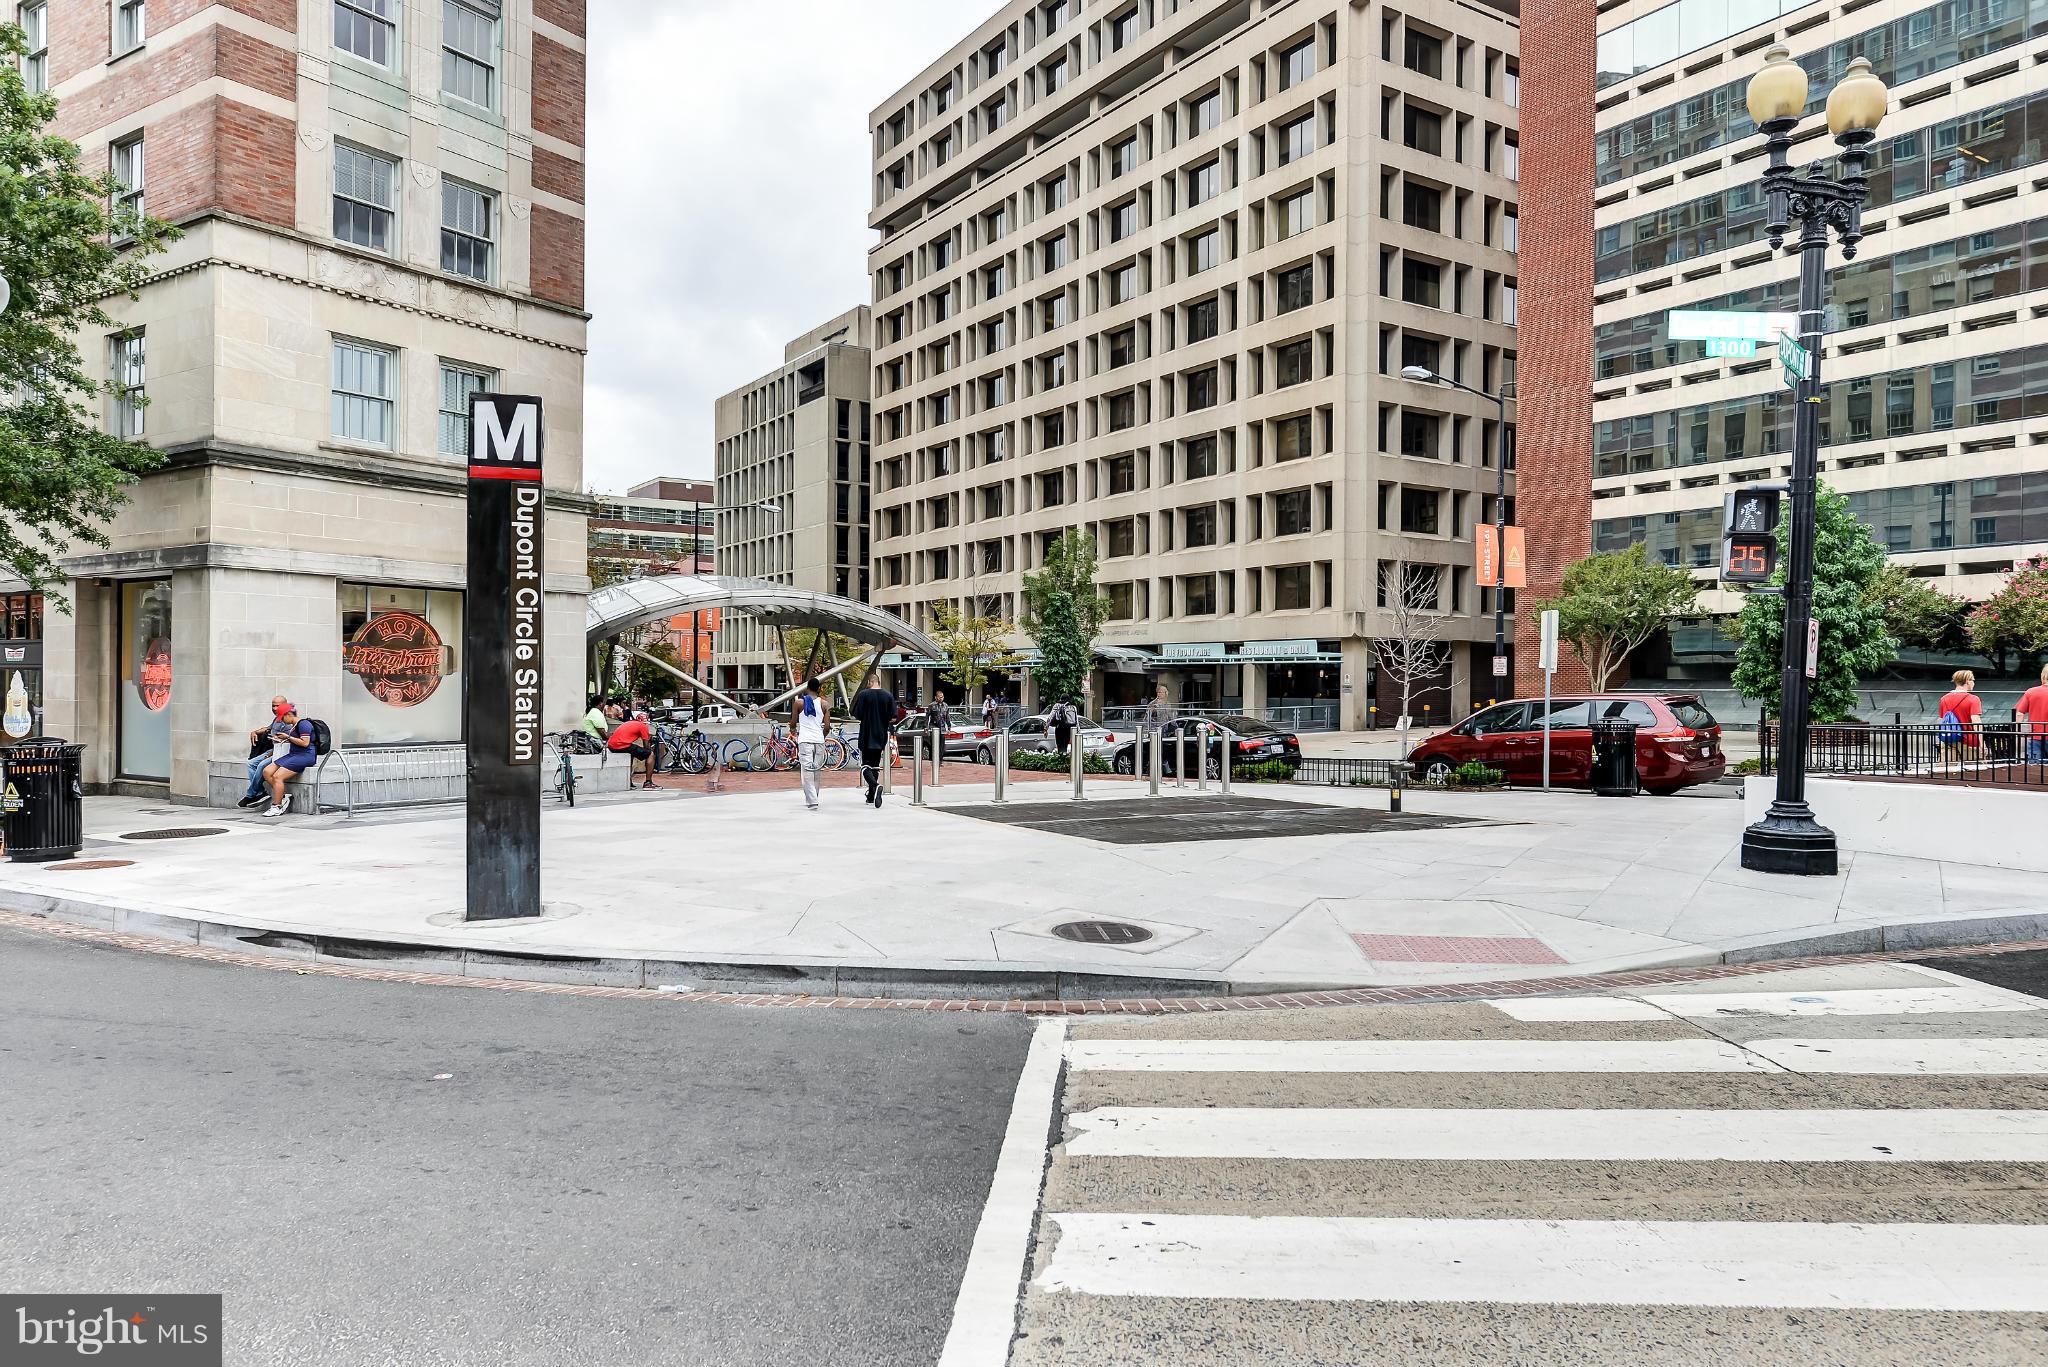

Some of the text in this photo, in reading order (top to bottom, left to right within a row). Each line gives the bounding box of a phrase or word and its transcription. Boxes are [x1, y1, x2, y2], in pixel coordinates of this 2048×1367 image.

[1710, 341, 1750, 356] 1300
[473, 401, 537, 461] M
[1483, 547, 1491, 581] STREET
[1729, 545, 1765, 572] 25
[375, 620, 420, 637] HOT
[511, 487, 539, 761] Dupont Circle Station
[1239, 646, 1281, 655] RESTAURANT
[1289, 644, 1310, 655] GRILL
[374, 681, 421, 702] NOW
